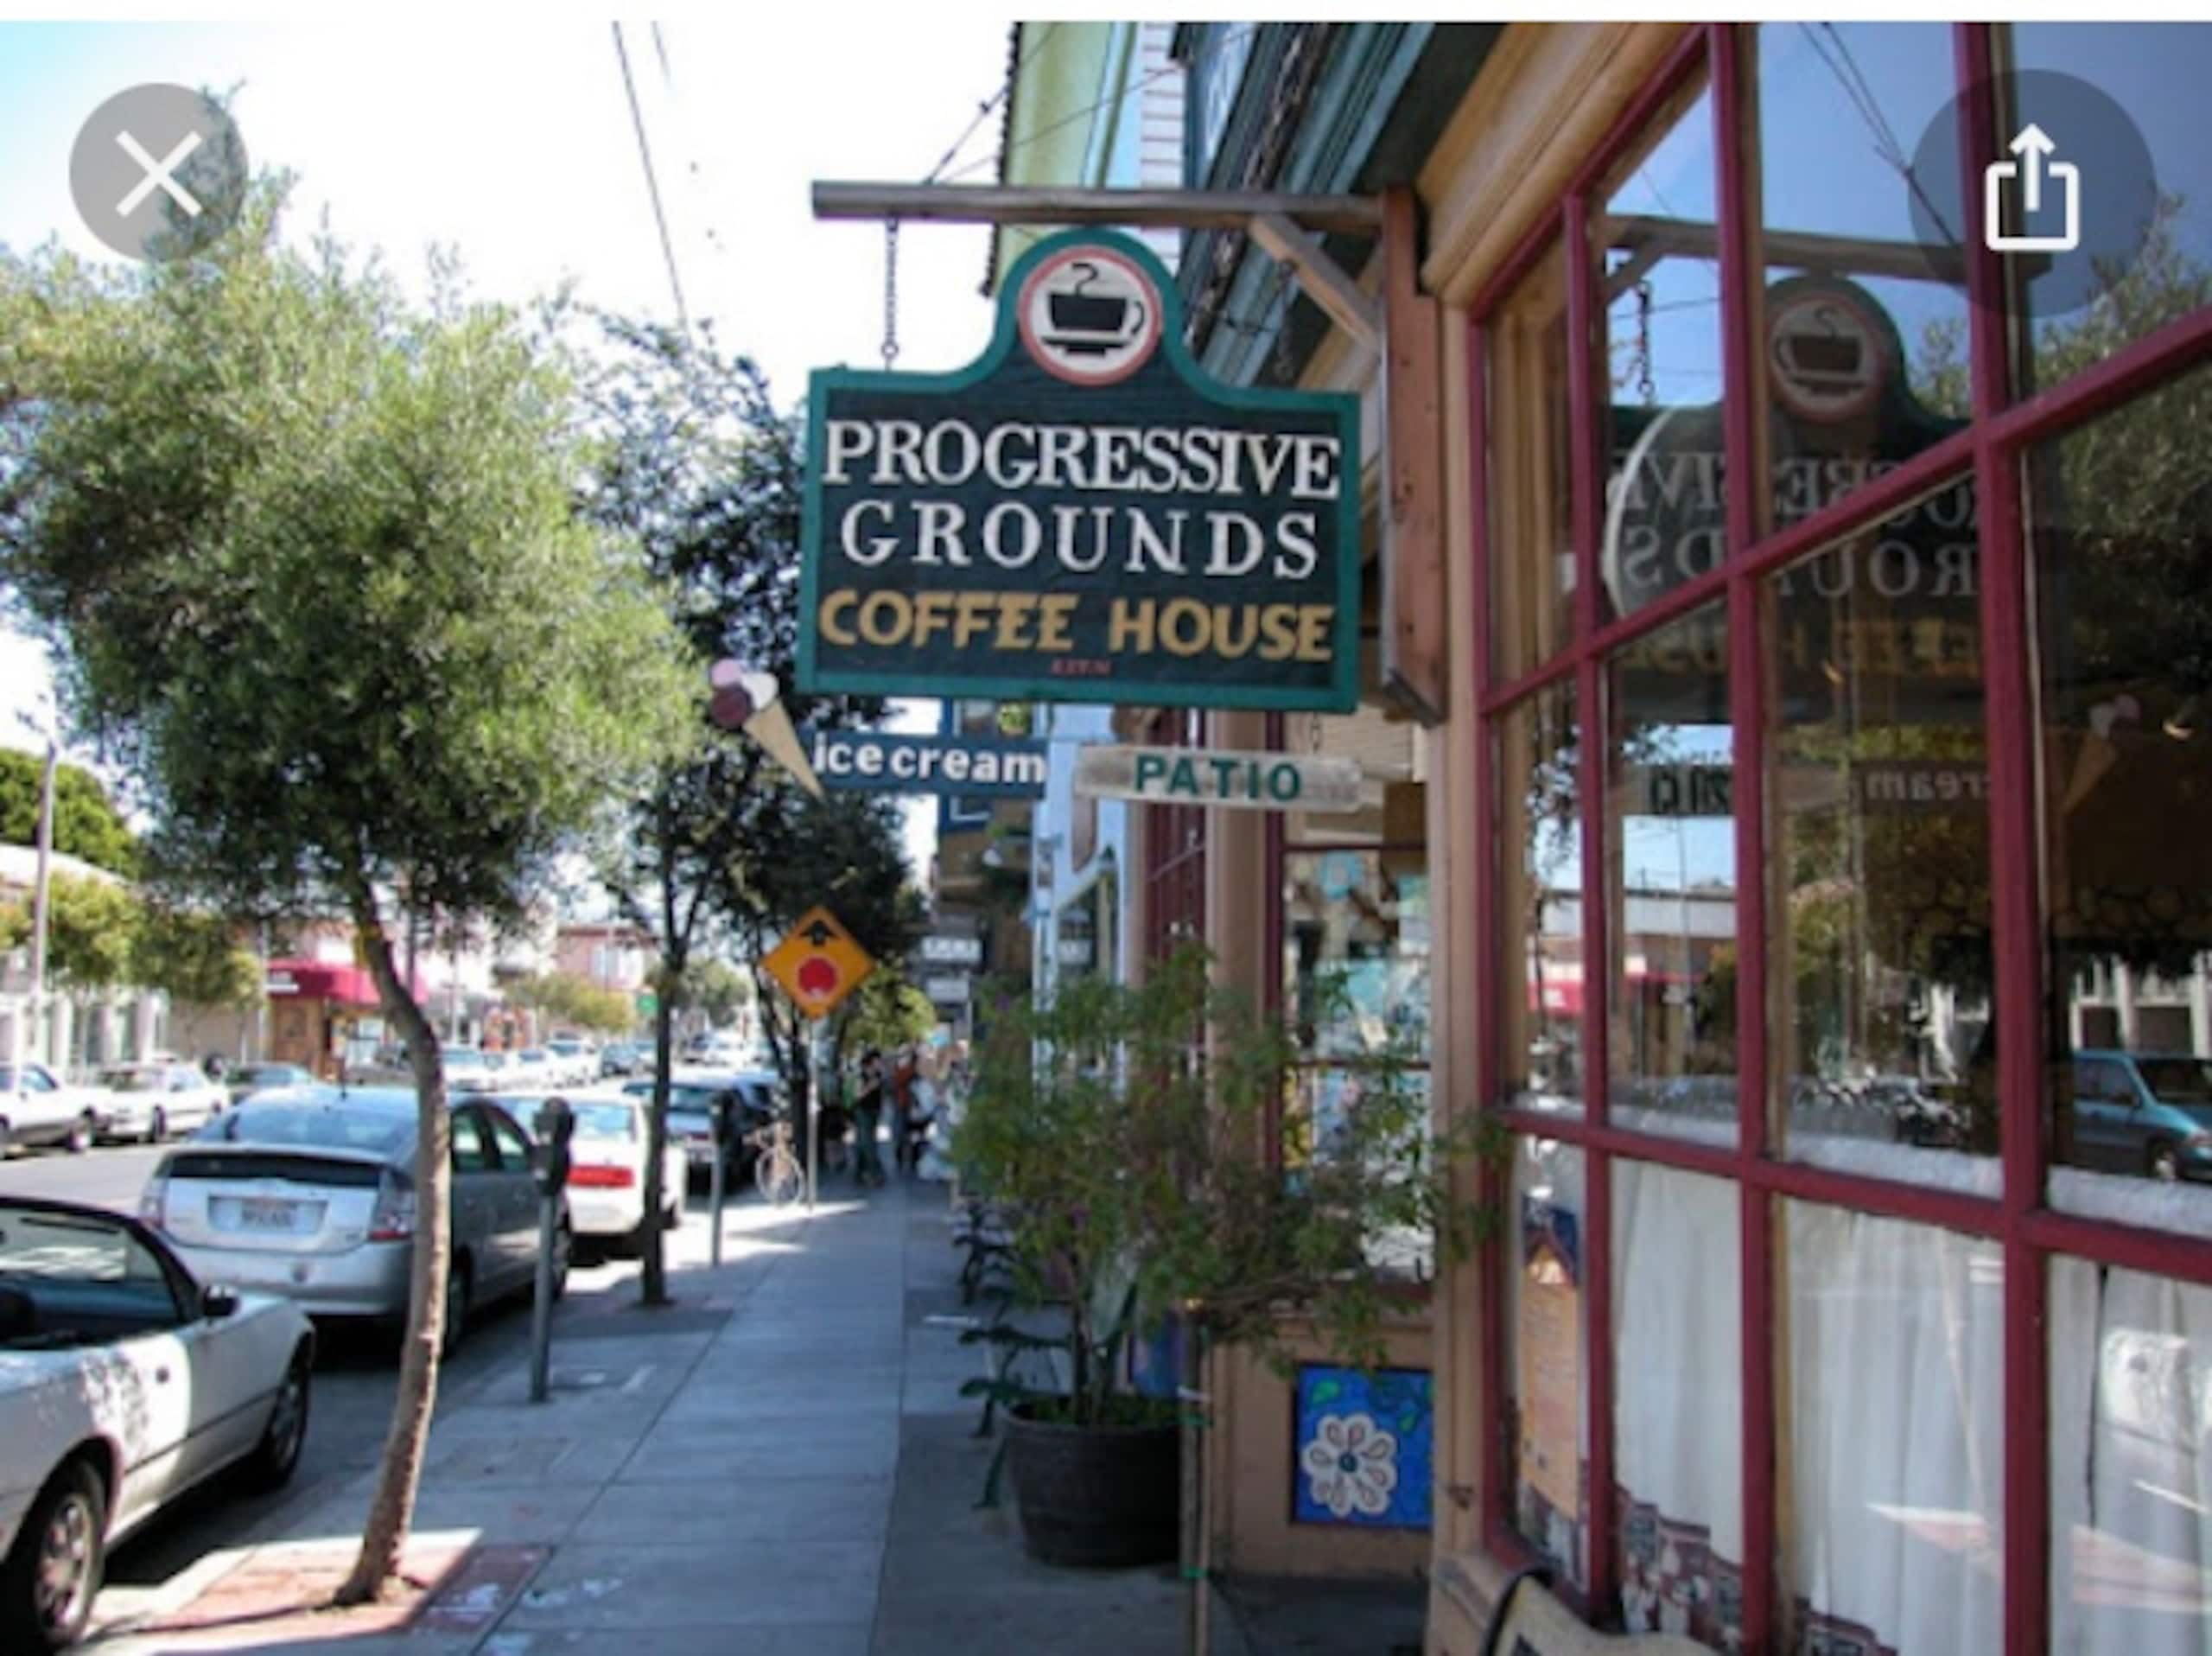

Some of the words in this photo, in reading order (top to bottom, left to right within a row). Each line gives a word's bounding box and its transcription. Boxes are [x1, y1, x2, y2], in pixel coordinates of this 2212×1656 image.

[822, 419, 1340, 500] PROGRESSIVE
[840, 497, 1319, 580] GROUNDS
[818, 589, 1079, 653] COFFEE
[1108, 598, 1335, 662] HOUSE
[811, 732, 884, 775] ice
[889, 745, 1047, 784] cream
[1134, 754, 1301, 801] PATIO
